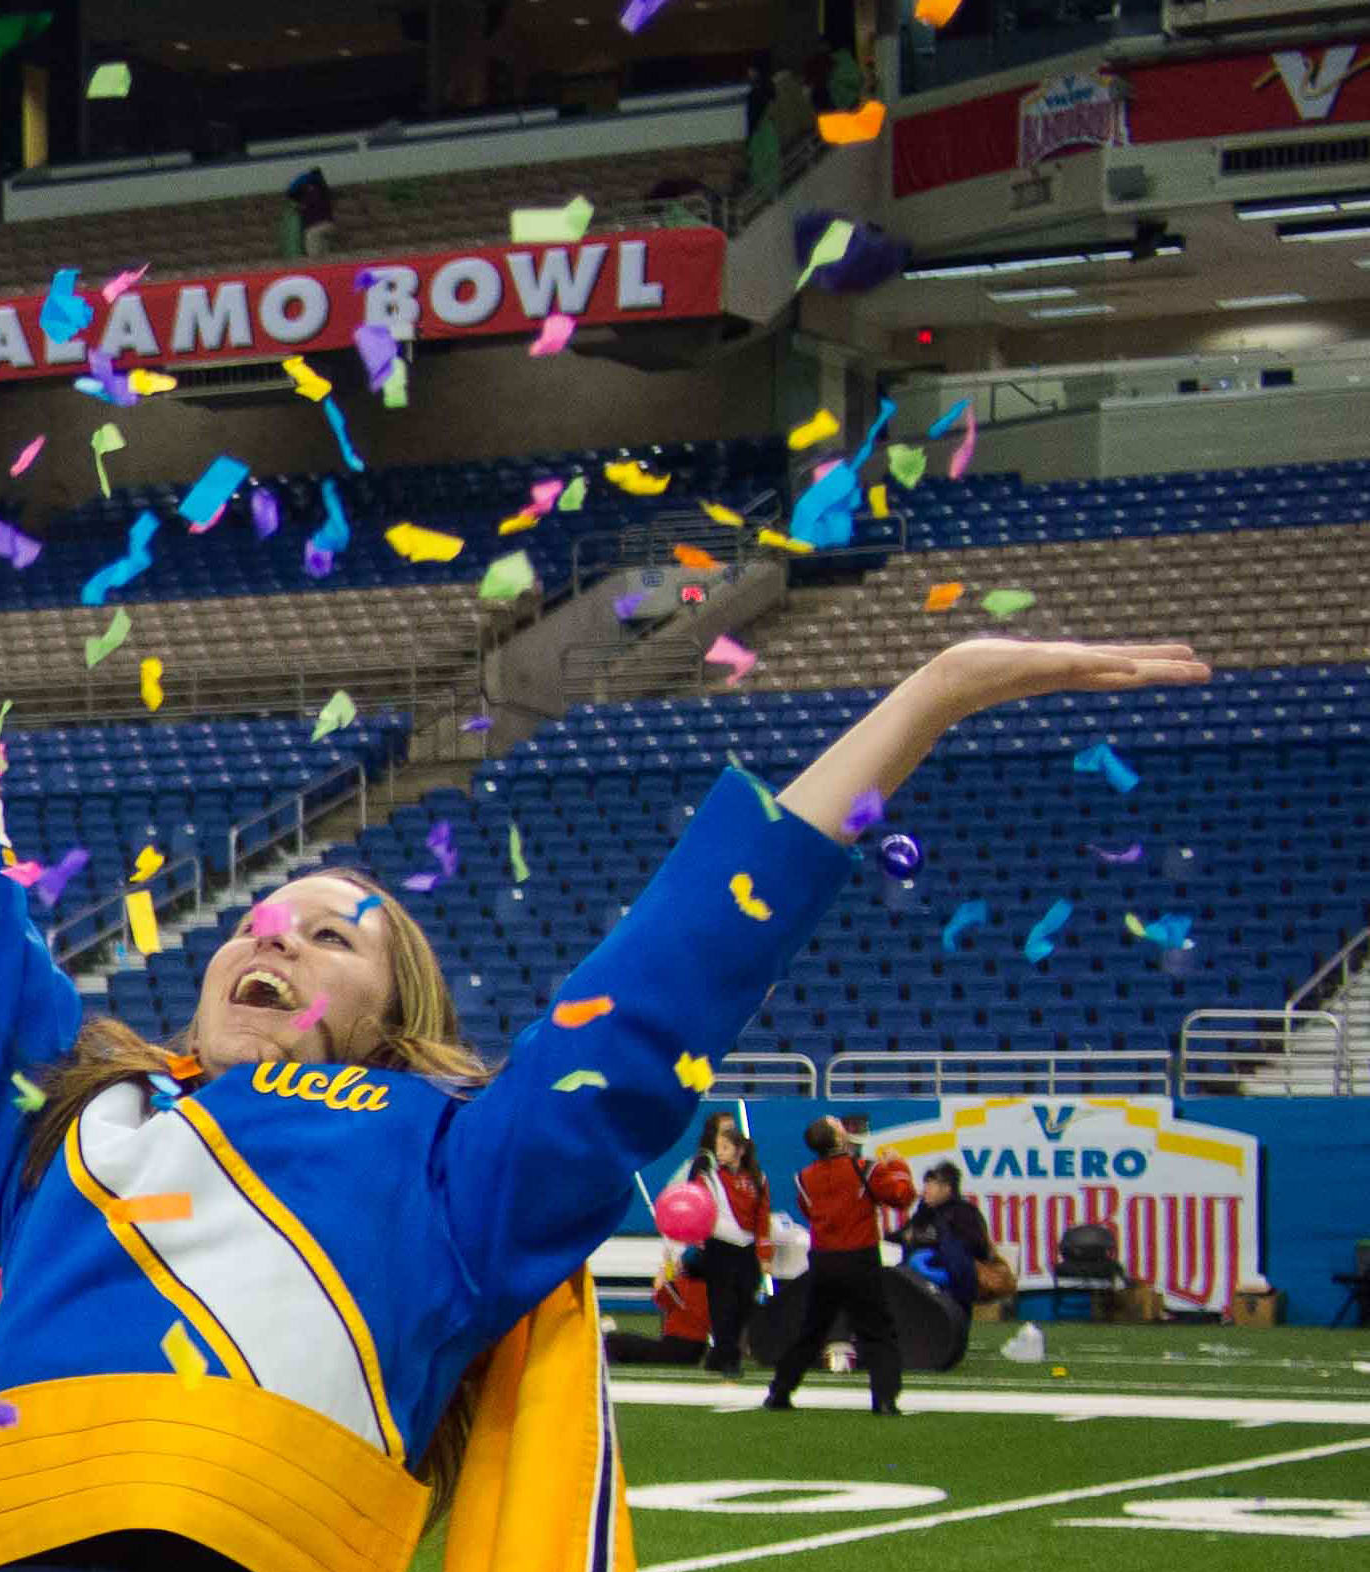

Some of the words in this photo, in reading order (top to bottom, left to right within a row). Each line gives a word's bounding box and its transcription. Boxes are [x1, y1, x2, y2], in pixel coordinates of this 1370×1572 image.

[364, 240, 663, 341] BOWL
[251, 1060, 390, 1112] Ucla
[961, 1149, 1148, 1179] VALERO
